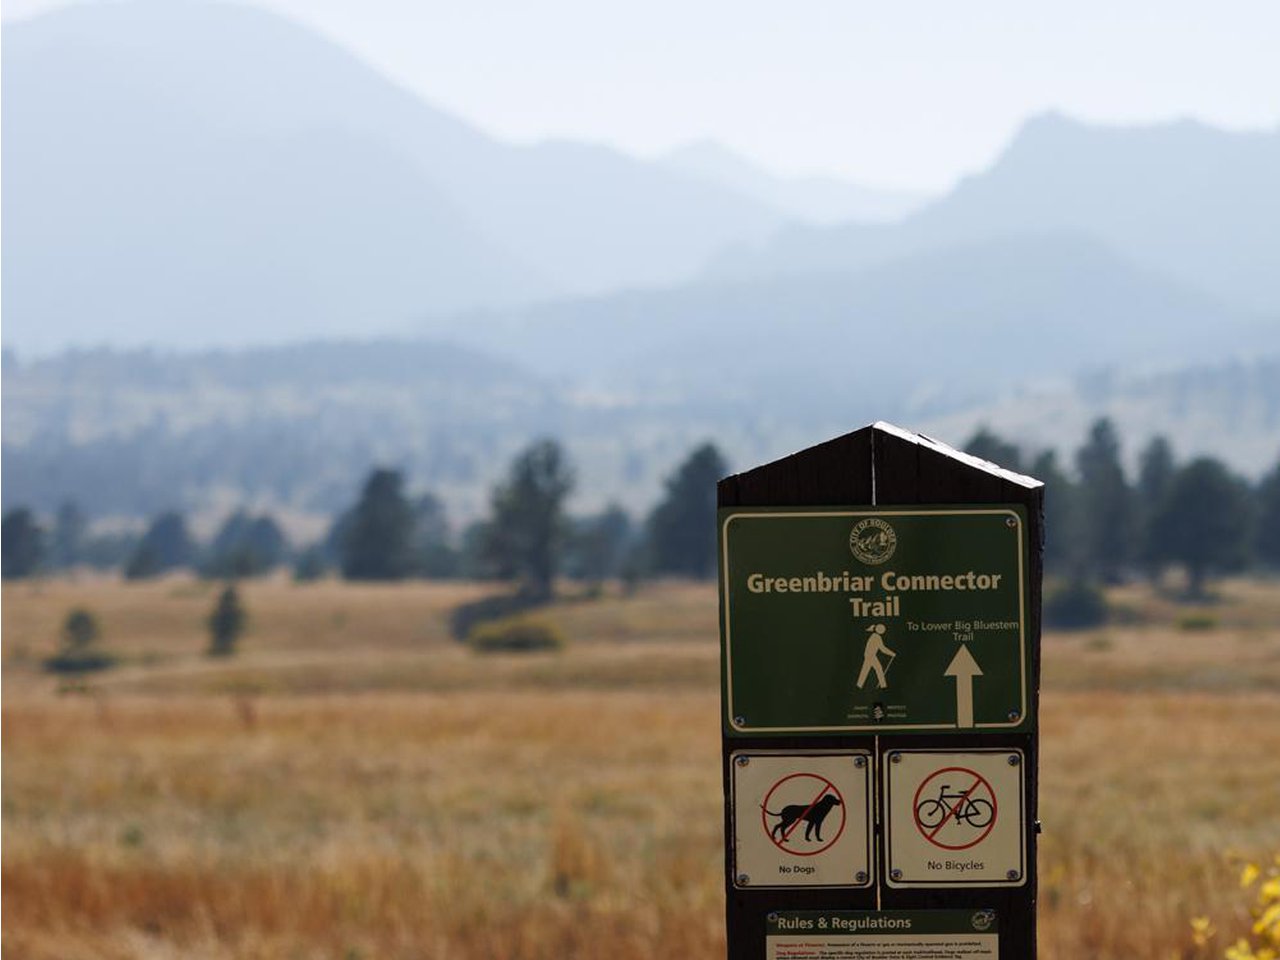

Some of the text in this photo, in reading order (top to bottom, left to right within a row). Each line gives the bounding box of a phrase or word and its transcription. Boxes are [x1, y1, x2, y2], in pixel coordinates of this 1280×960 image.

[747, 571, 1002, 593] Greenbriar Connector
[849, 596, 900, 617] Trail
[907, 620, 1019, 632] To Lower Big Bluestem
[952, 632, 974, 641] Trail
[779, 865, 816, 876] No Dogs
[927, 860, 985, 873] No Bicycles
[777, 916, 912, 931] Rules & Regulations
